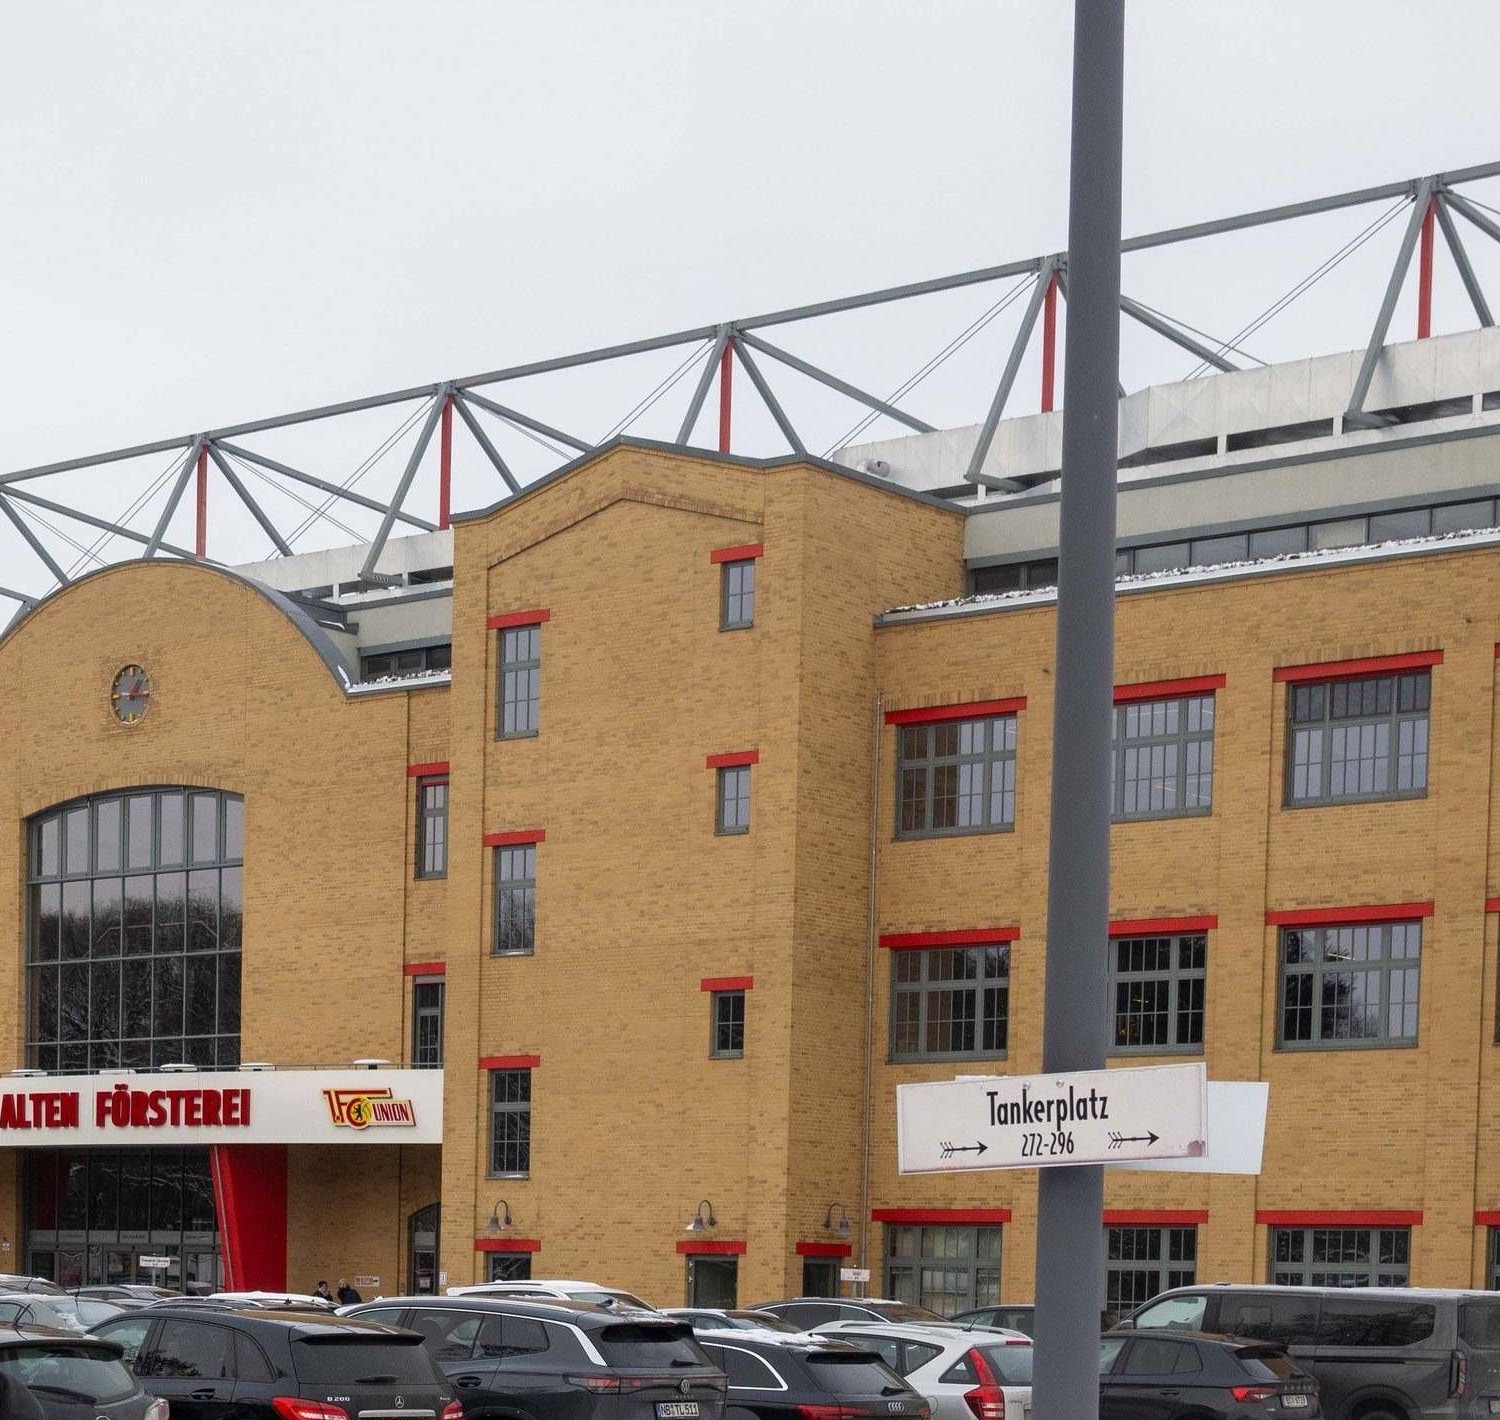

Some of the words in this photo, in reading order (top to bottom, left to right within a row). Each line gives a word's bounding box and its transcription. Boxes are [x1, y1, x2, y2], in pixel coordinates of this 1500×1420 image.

[0, 1092, 80, 1129] ALTEN
[96, 1083, 251, 1128] FÖRSTEREI
[372, 1103, 410, 1122] UNION
[986, 1086, 1109, 1131] Tankerplatz
[1021, 1132, 1075, 1157] 272-296
